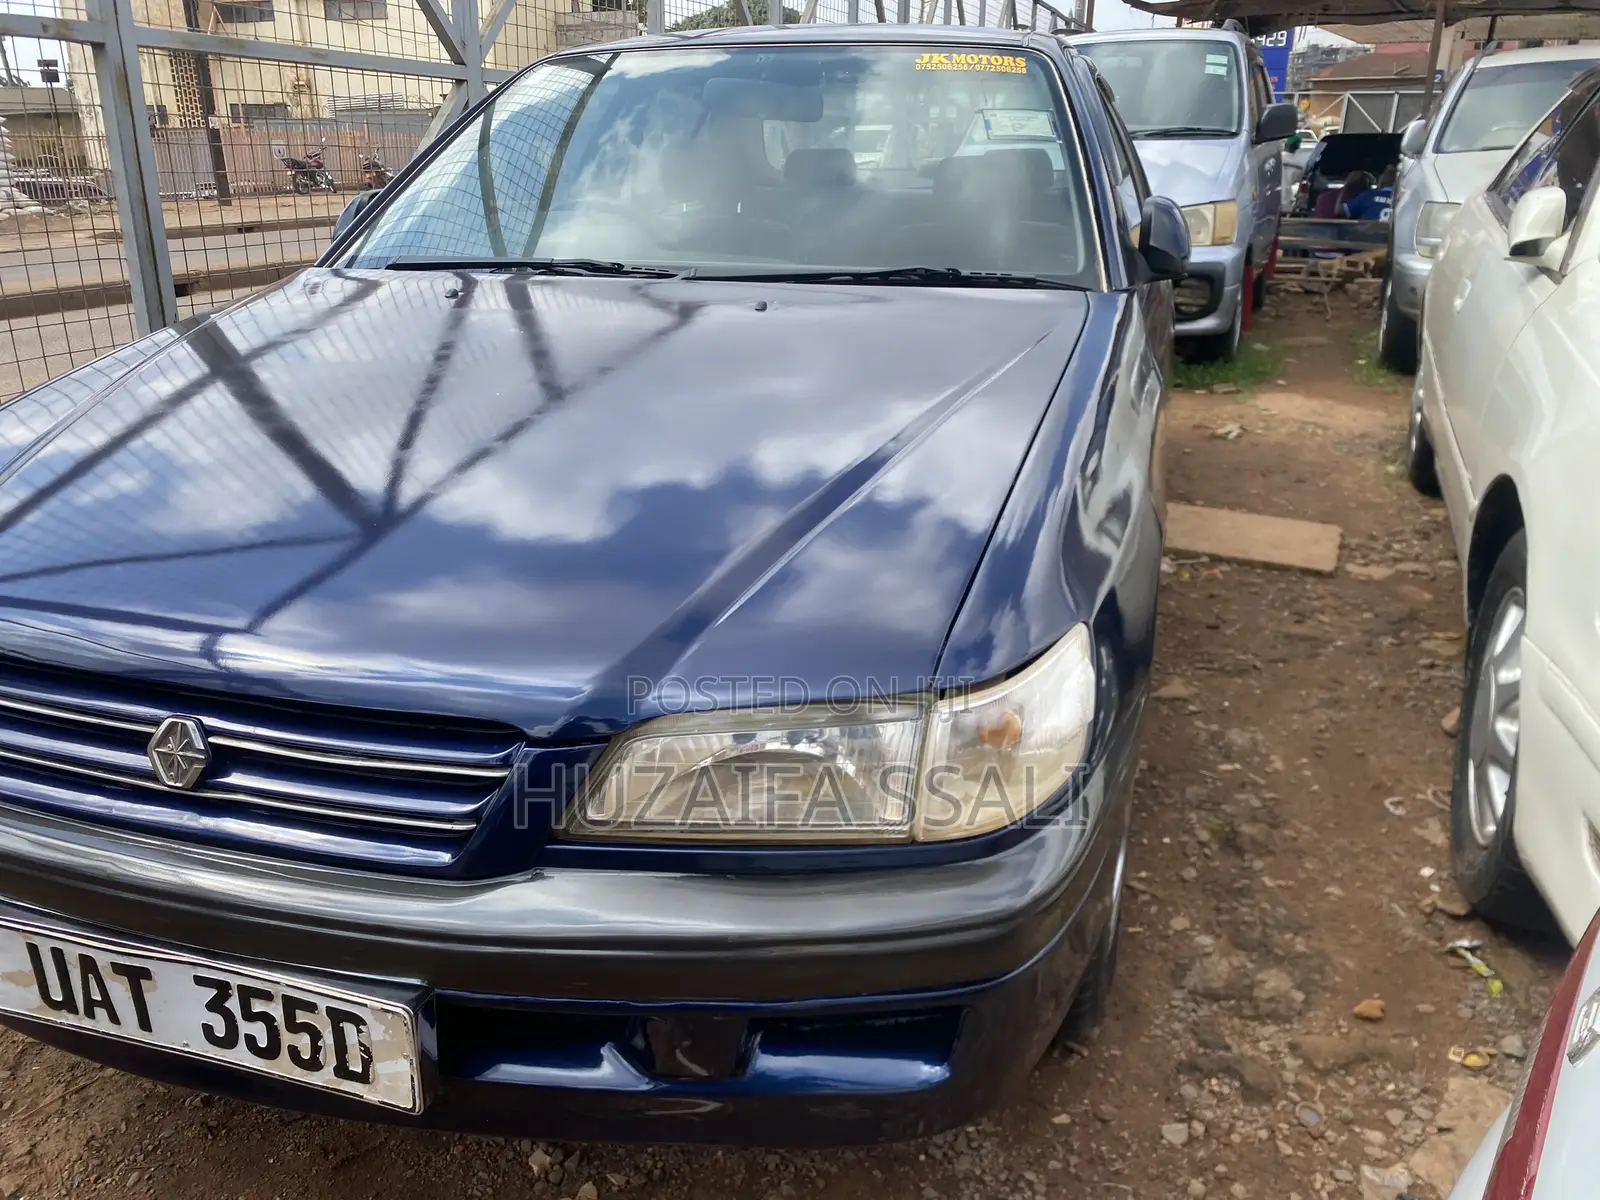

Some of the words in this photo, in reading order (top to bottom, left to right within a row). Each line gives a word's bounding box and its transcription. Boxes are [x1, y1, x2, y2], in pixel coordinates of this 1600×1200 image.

[1251, 30, 1288, 47] 429
[915, 53, 951, 64] JK
[951, 53, 1026, 67] MOTORS
[25, 941, 153, 1034] UAT
[193, 974, 374, 1085] 355D
